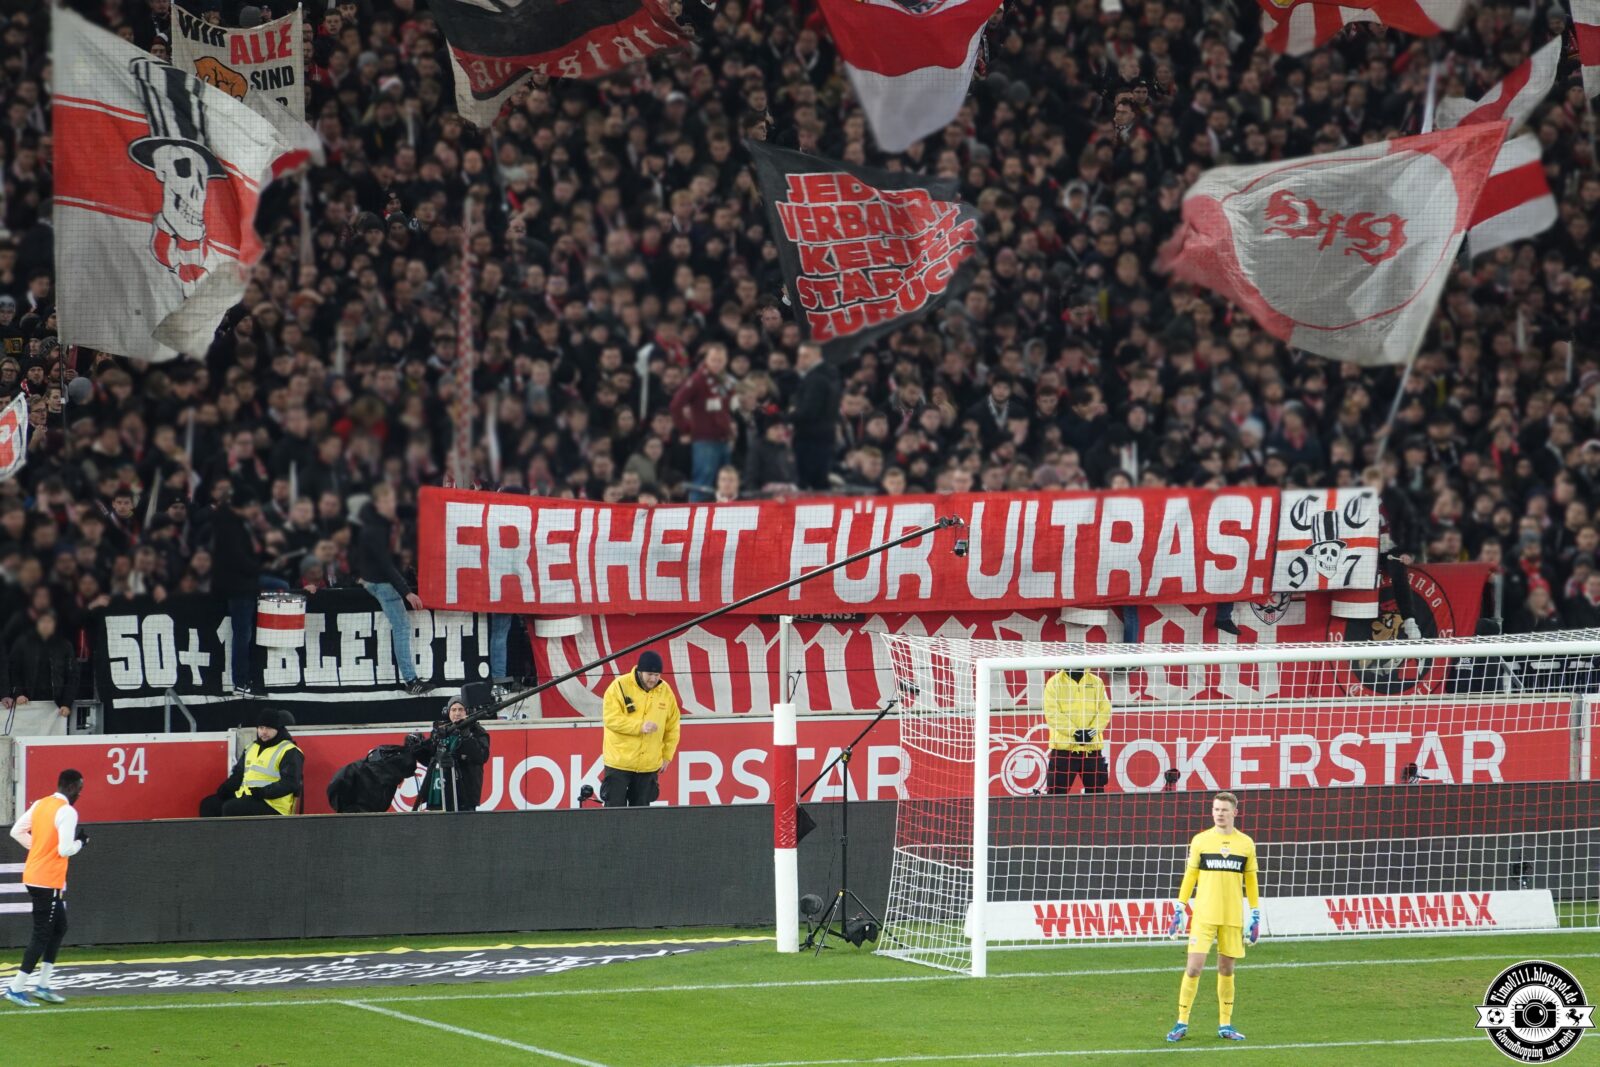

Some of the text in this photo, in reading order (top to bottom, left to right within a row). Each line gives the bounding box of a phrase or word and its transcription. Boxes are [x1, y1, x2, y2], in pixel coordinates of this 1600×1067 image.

[178, 10, 228, 48] WIR
[230, 22, 293, 65] ALLE
[250, 65, 295, 91] SIND
[445, 494, 1273, 604] FREIHEIT FÜR ULTRAS!
[106, 747, 148, 785] 34
[475, 745, 911, 812] JOKRSAR
[1205, 859, 1243, 871] WINAMAX
[1327, 893, 1498, 931] WINAMAX
